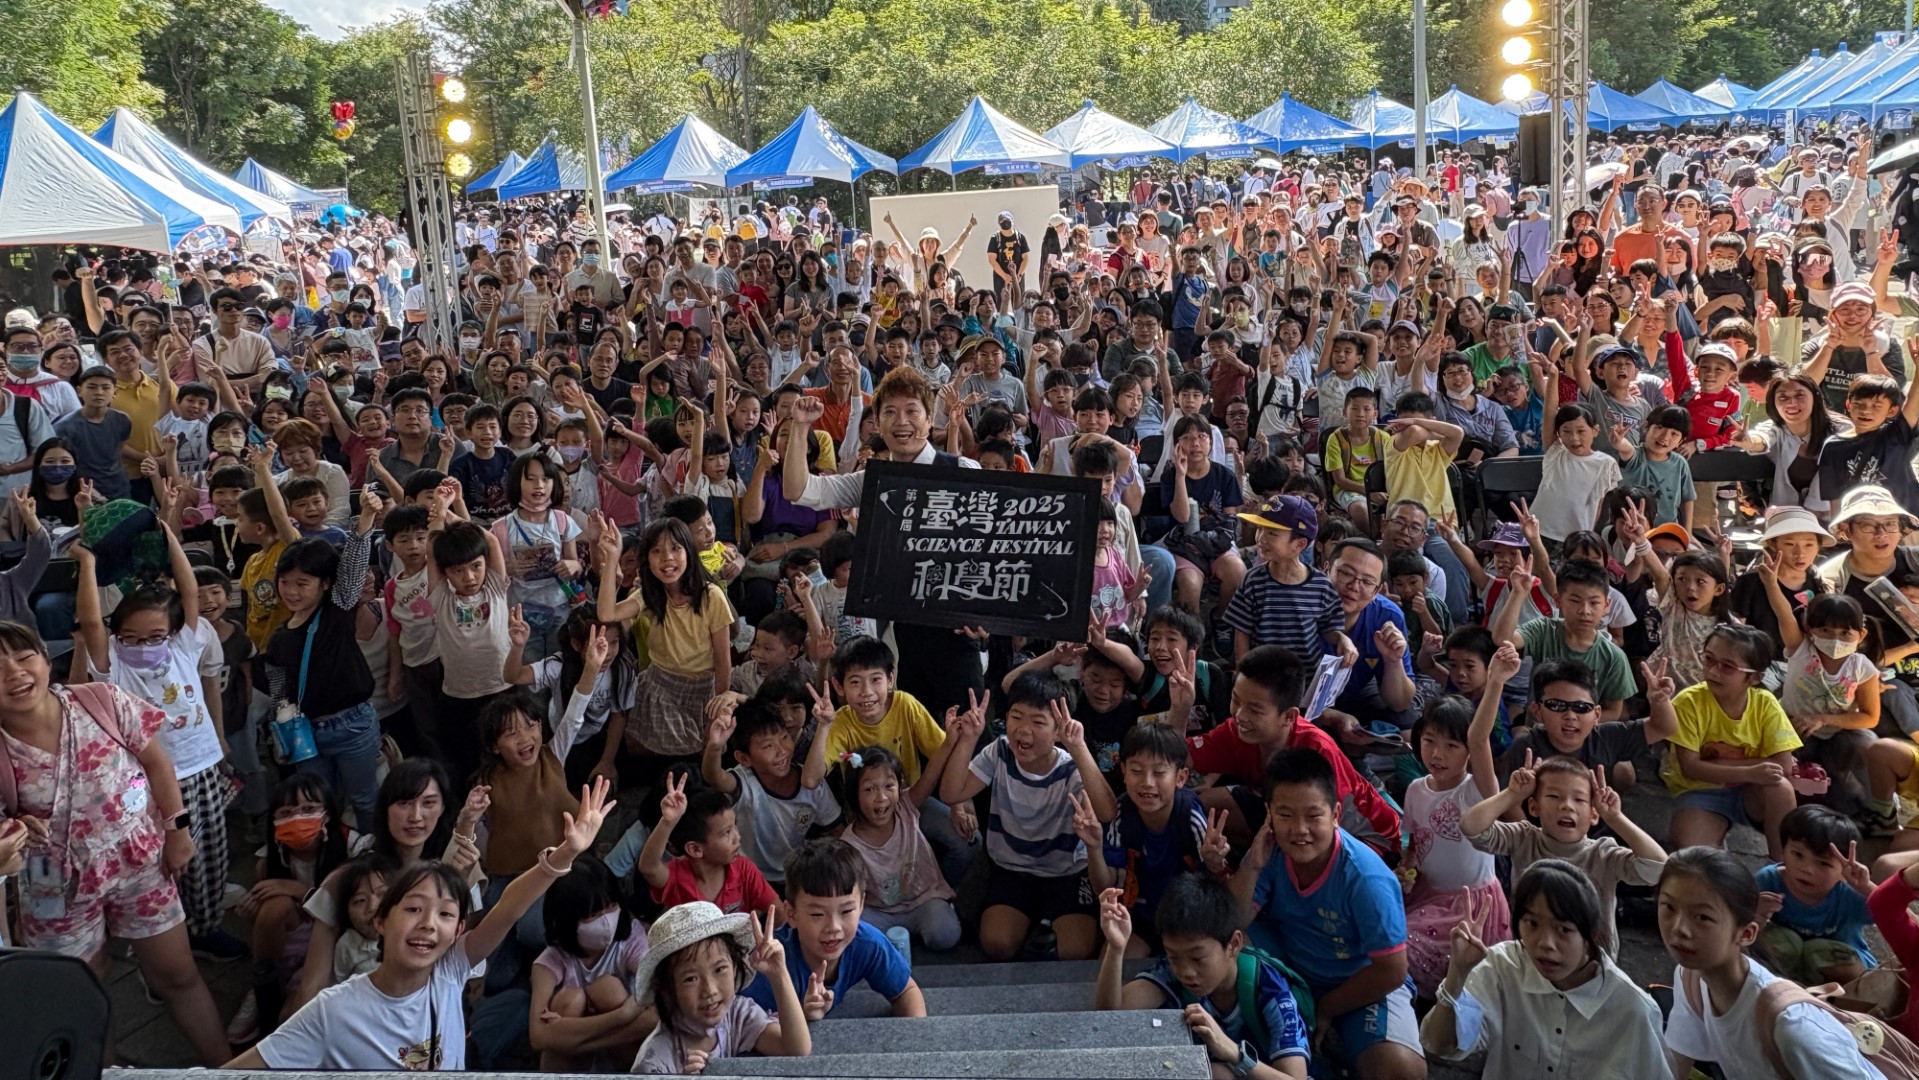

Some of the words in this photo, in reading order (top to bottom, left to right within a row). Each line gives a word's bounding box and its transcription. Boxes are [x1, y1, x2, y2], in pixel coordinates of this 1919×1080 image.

[919, 489, 999, 534] 臺灣
[1002, 494, 1067, 516] 2025
[995, 518, 1071, 535] TAIWAN
[904, 537, 985, 553] SCIENCE
[987, 537, 1074, 555] FESTIVAL
[910, 558, 1033, 602] 科學節
